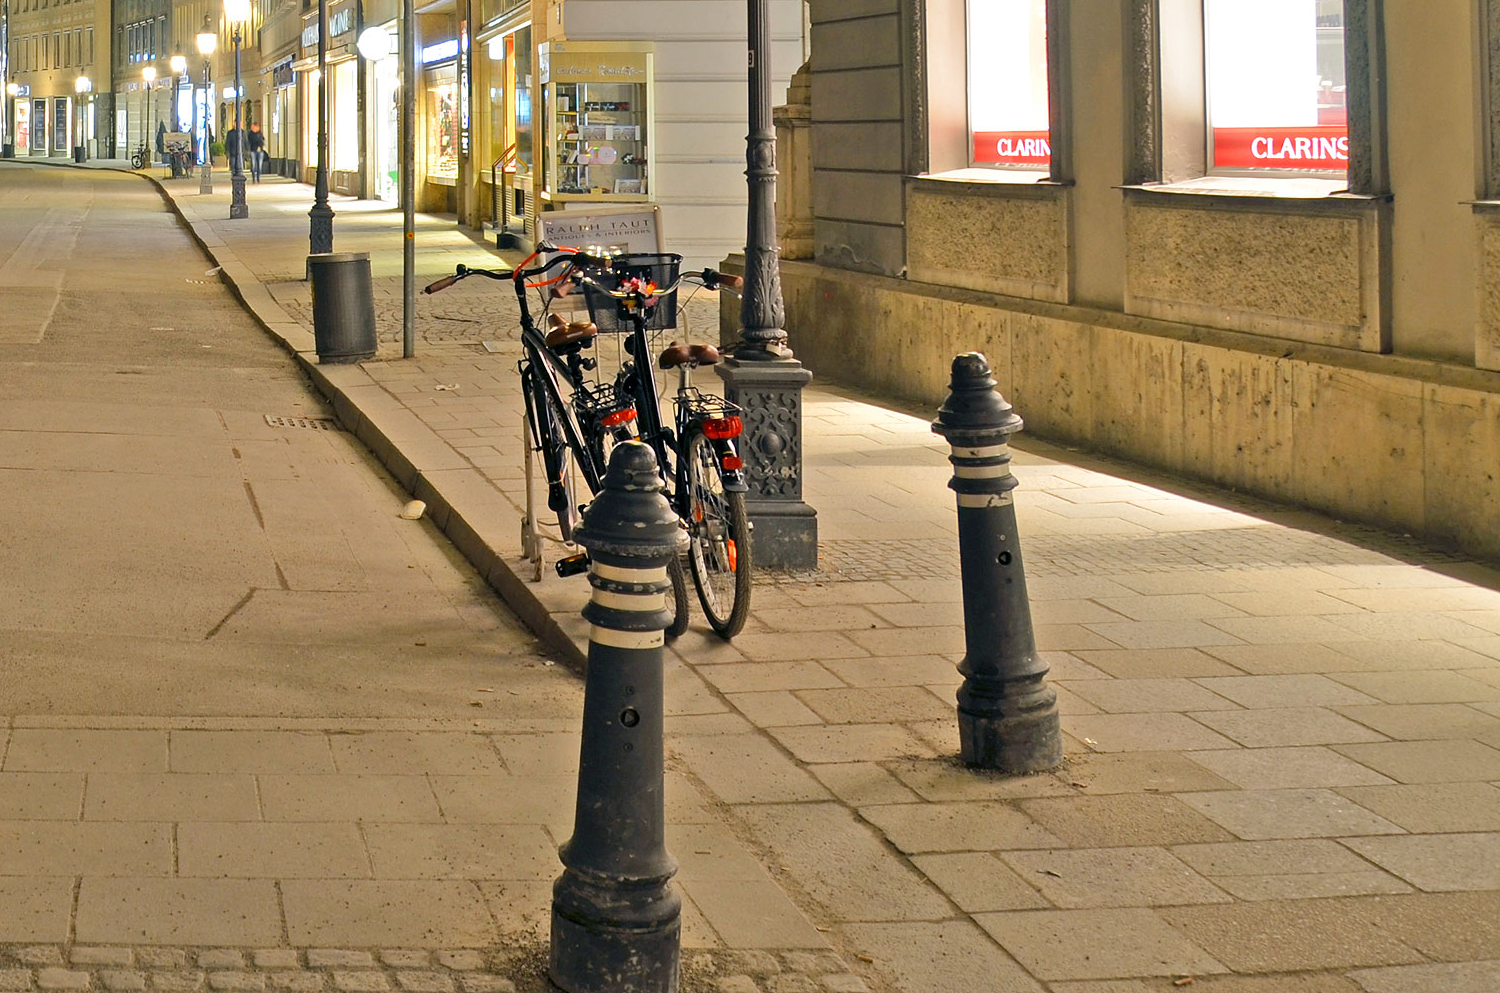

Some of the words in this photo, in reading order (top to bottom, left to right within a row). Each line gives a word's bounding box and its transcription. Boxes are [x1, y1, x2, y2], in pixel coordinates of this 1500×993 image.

[996, 138, 1051, 157] CLARIN
[1251, 136, 1349, 160] CLARINS
[611, 219, 649, 229] TAUT
[605, 228, 651, 238] INTERIORS
